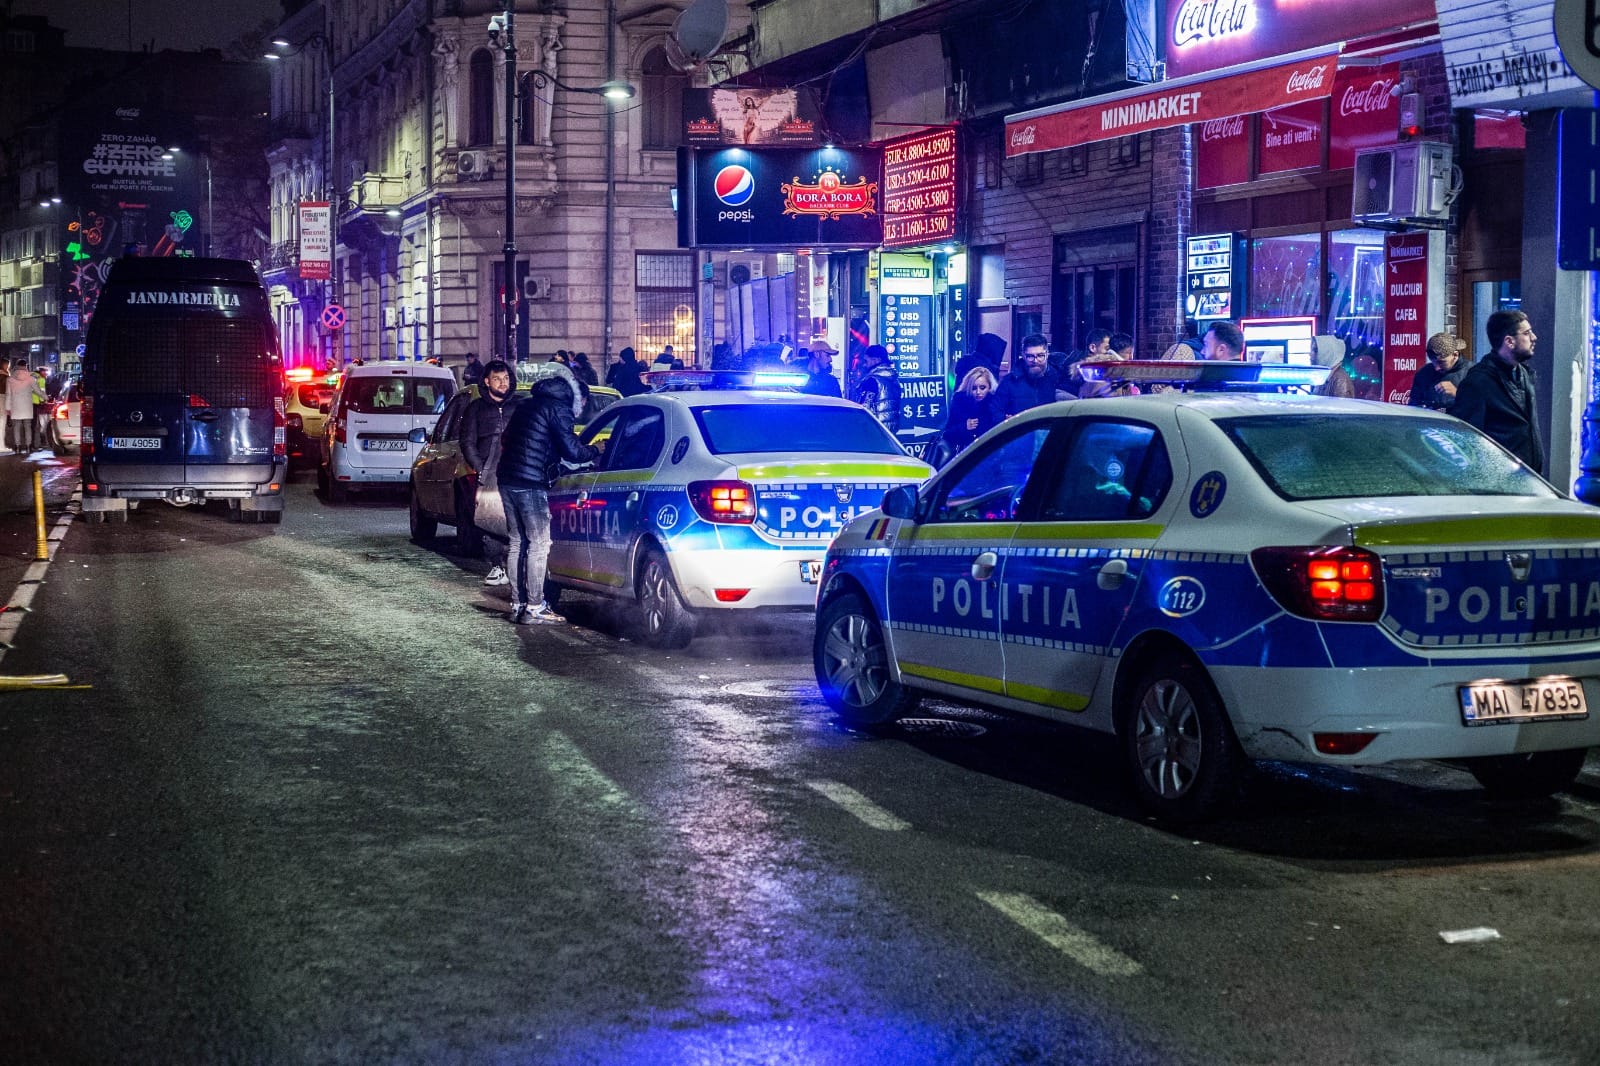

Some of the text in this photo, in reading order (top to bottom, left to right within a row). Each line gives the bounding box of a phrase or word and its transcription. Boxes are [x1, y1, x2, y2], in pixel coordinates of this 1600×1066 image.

[1286, 66, 1327, 94] Coca-Cola
[1340, 78, 1393, 117] Coca-Cola
[1101, 92, 1201, 131] MINIMARKET
[1266, 132, 1281, 148] Bine
[1283, 130, 1293, 144] ati
[796, 193, 863, 203] BORA BORA
[718, 209, 751, 222] pepsi
[1390, 246, 1424, 257] MINIMARKET
[1390, 283, 1423, 296] DULCIURI
[127, 291, 240, 306] JANDARMERIA
[900, 297, 919, 305] EUR
[1395, 308, 1417, 321] CAFEA
[900, 328, 919, 336] GBP
[1390, 334, 1421, 346] BAUTURI
[900, 345, 919, 353] CHF
[900, 362, 919, 370] CAD
[1393, 358, 1417, 371] TIGARI
[113, 437, 159, 448] MAI 49059
[560, 509, 620, 536] POLITIA
[663, 513, 673, 525] 112
[932, 576, 1082, 629] POLITIA
[1172, 591, 1196, 610] 112
[1425, 582, 1600, 623] POLITIA
[1474, 689, 1510, 717] MAI
[1521, 685, 1581, 713] 47835
